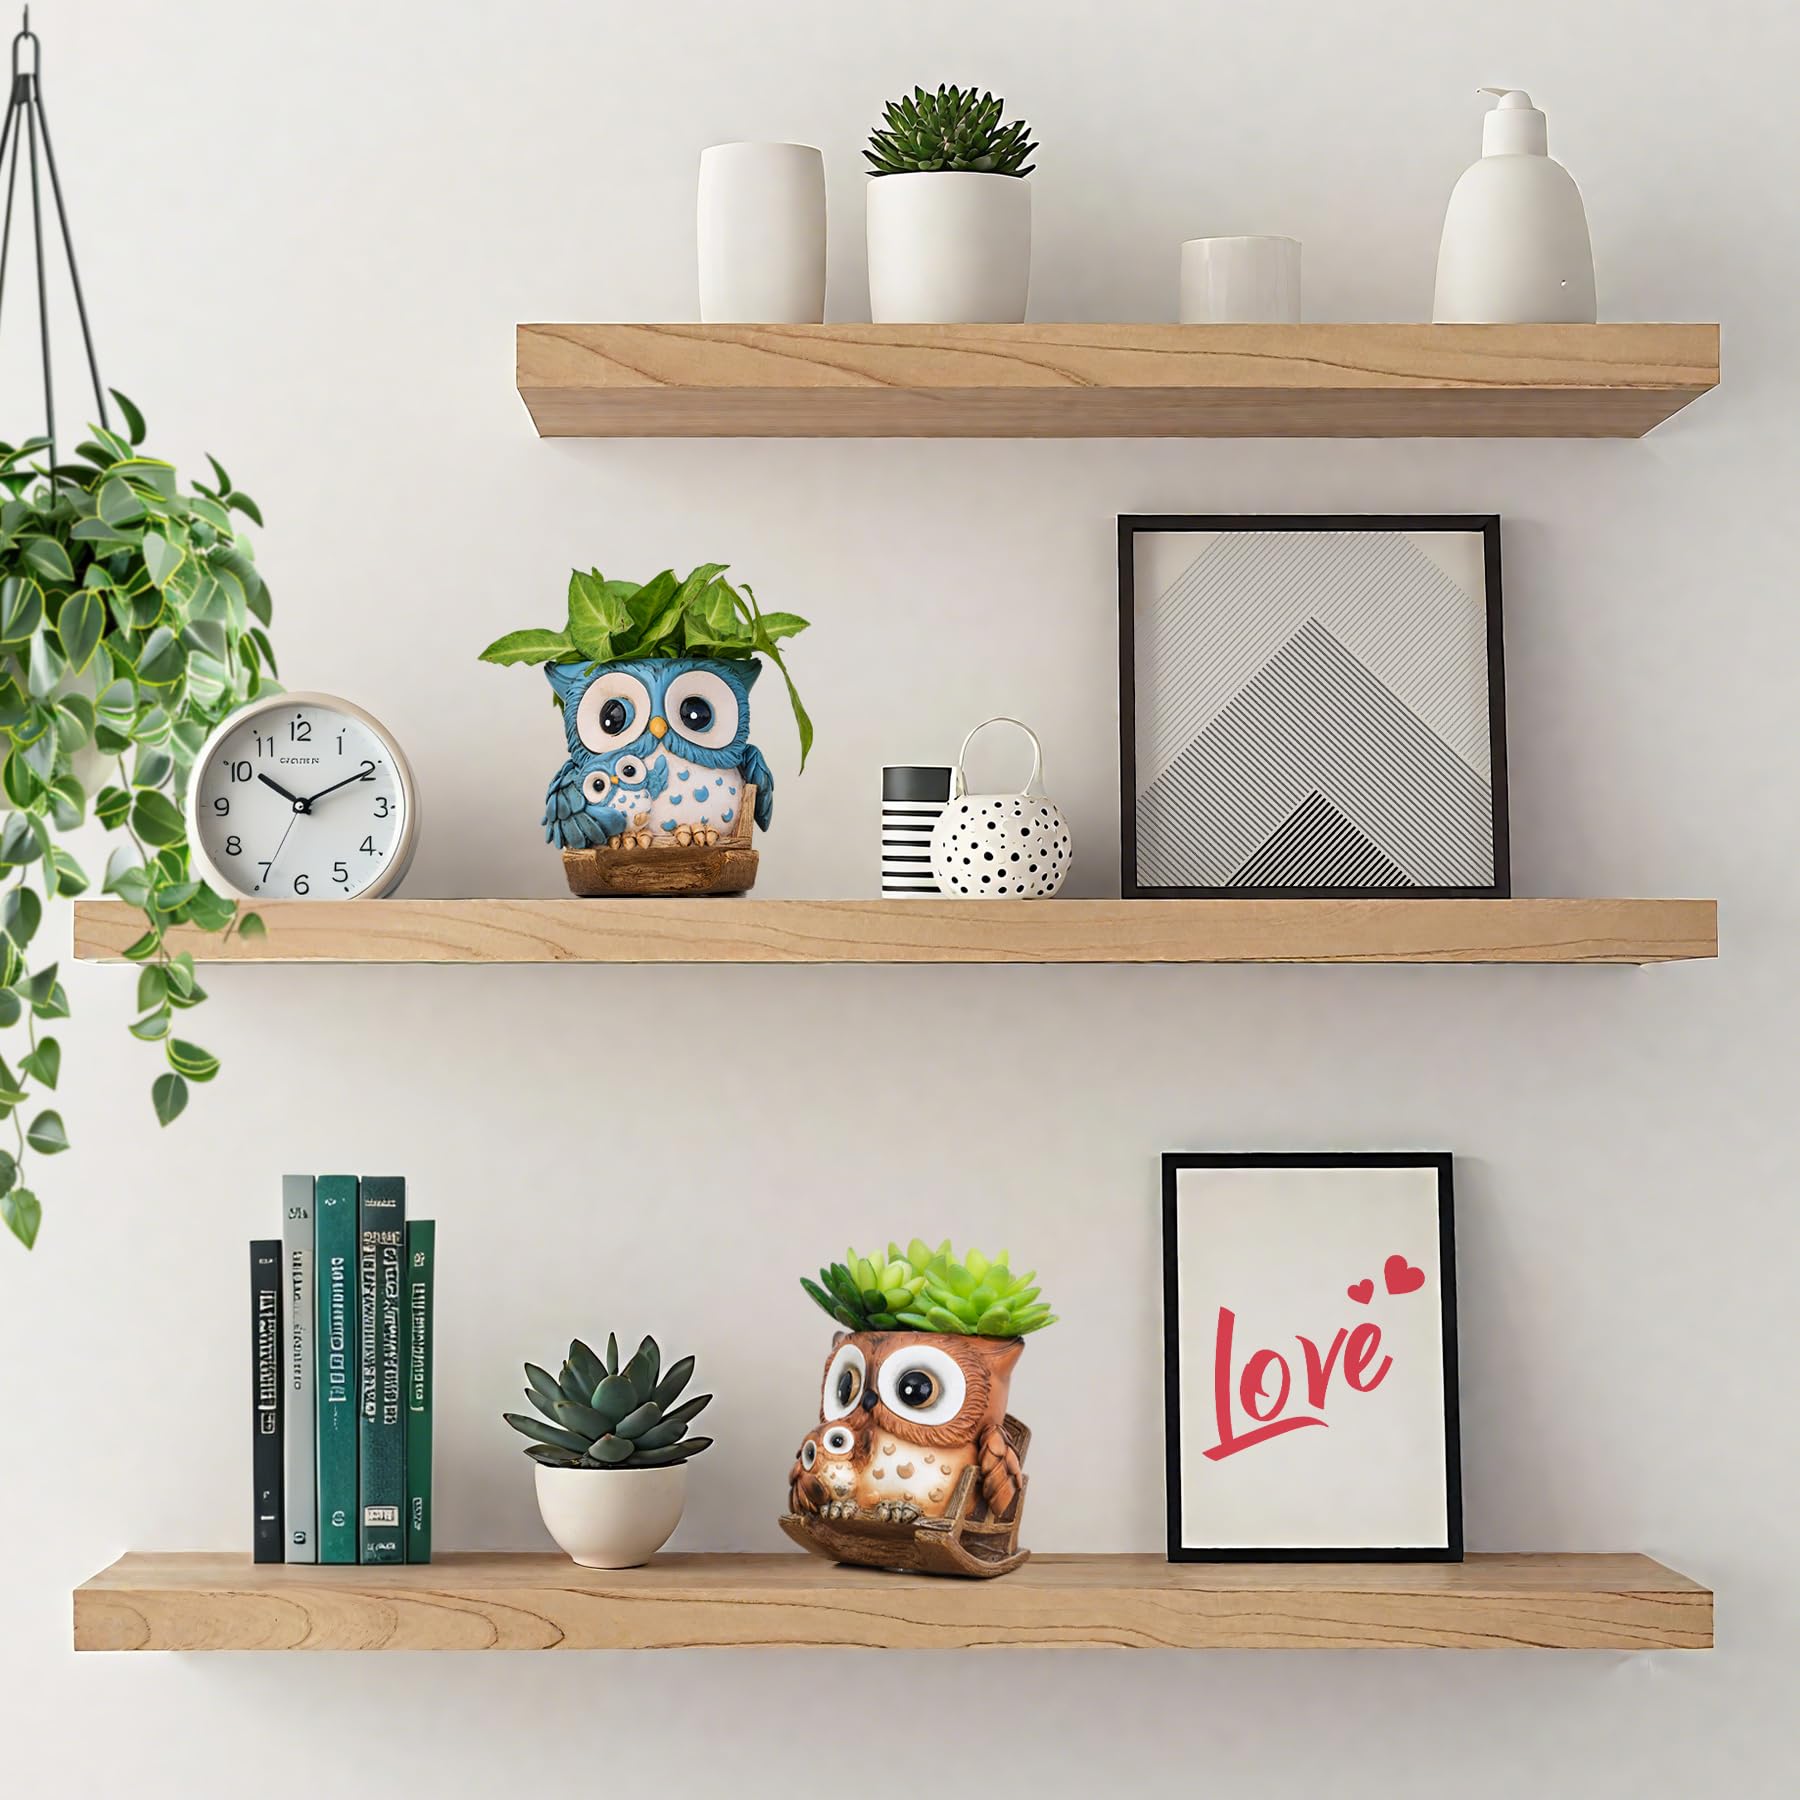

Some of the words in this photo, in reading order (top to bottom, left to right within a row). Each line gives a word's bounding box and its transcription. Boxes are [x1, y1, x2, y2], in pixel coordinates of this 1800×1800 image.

[290, 721, 311, 741] 12
[255, 736, 274, 757] 11
[336, 736, 343, 755] 1
[231, 760, 253, 782] 10
[359, 760, 376, 781] 2
[214, 797, 230, 817] 9
[373, 797, 389, 818] 3
[225, 835, 242, 856] 8
[359, 835, 376, 856] 4
[257, 862, 272, 883] 7
[332, 862, 349, 883] 5
[293, 874, 310, 895] 6
[1202, 1306, 1393, 1461] Love
